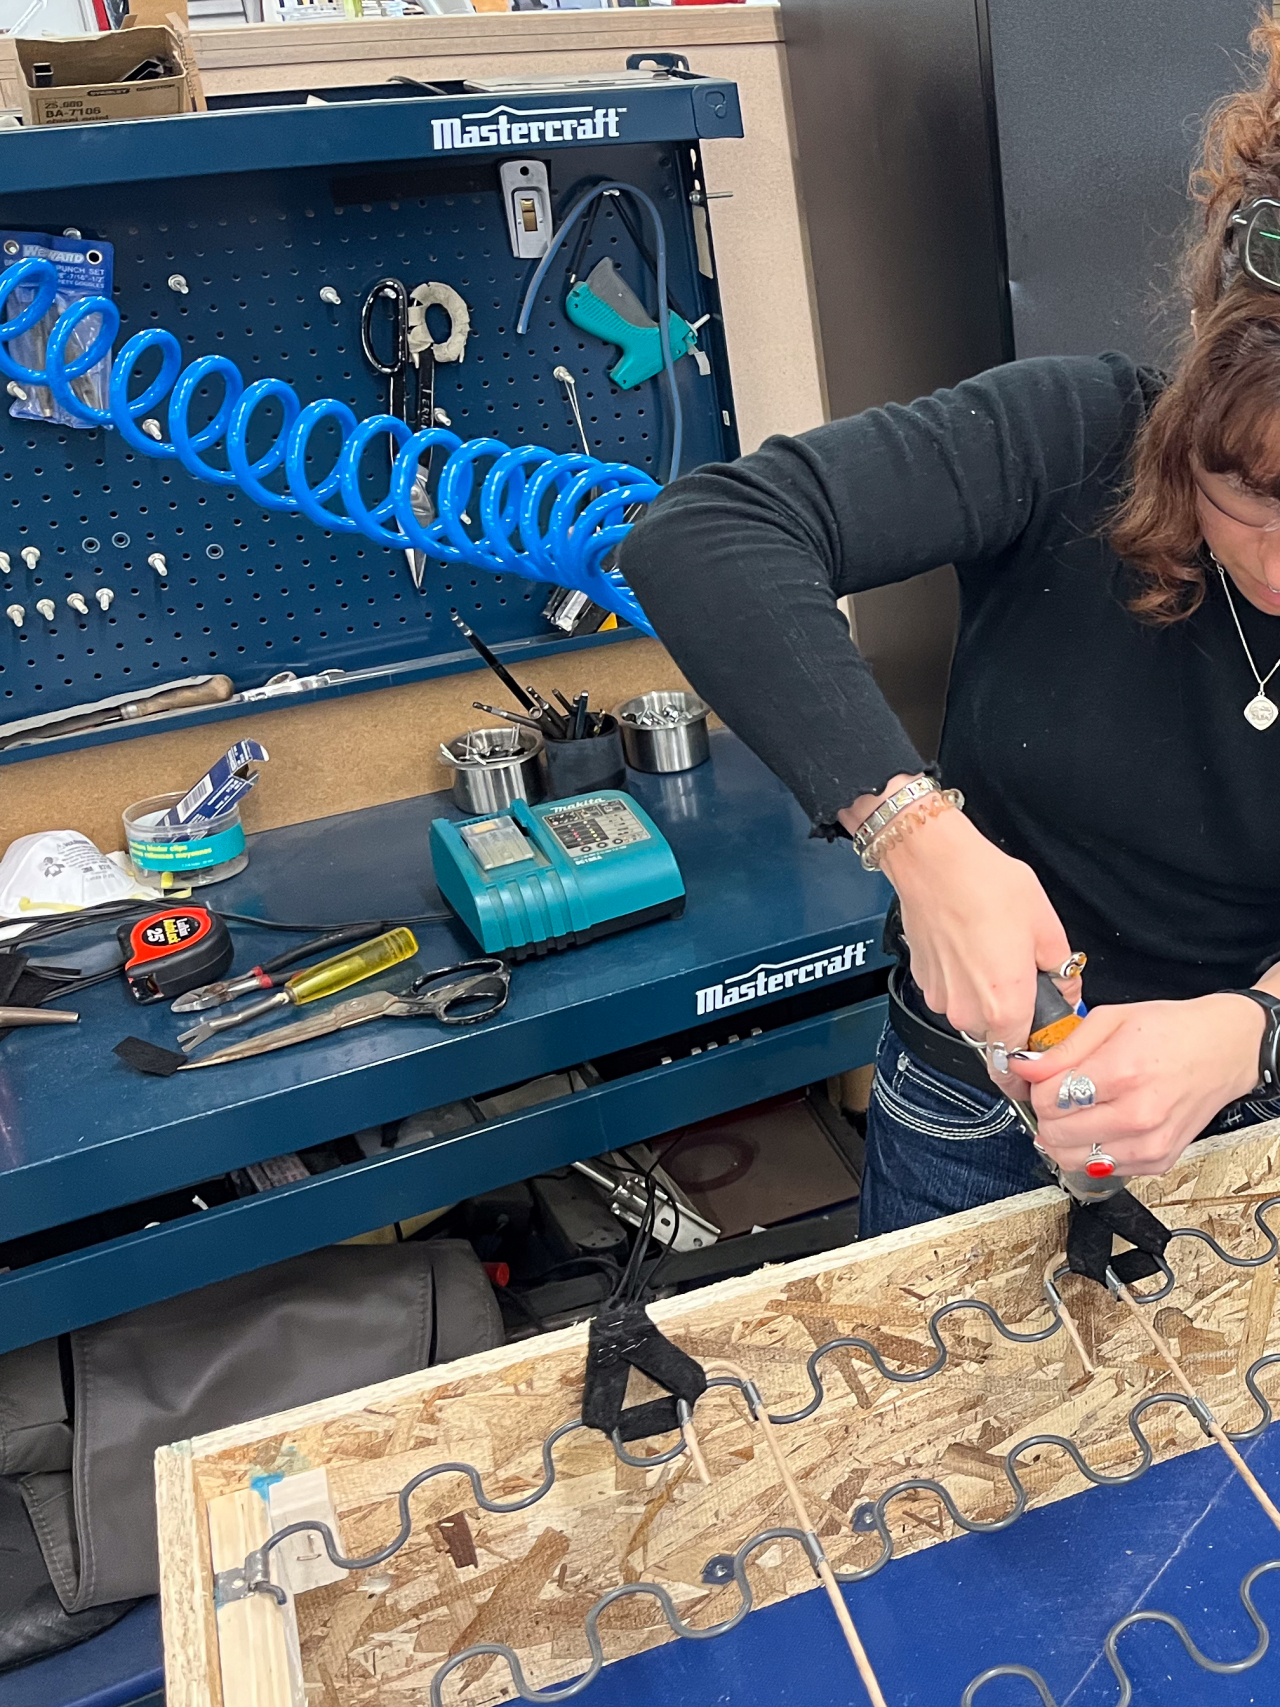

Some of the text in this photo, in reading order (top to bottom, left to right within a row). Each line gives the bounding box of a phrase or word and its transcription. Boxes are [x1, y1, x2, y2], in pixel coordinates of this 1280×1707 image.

[431, 108, 620, 150] Mastercraft
[88, 268, 105, 276] SET
[695, 941, 867, 1016] Mastercraft
